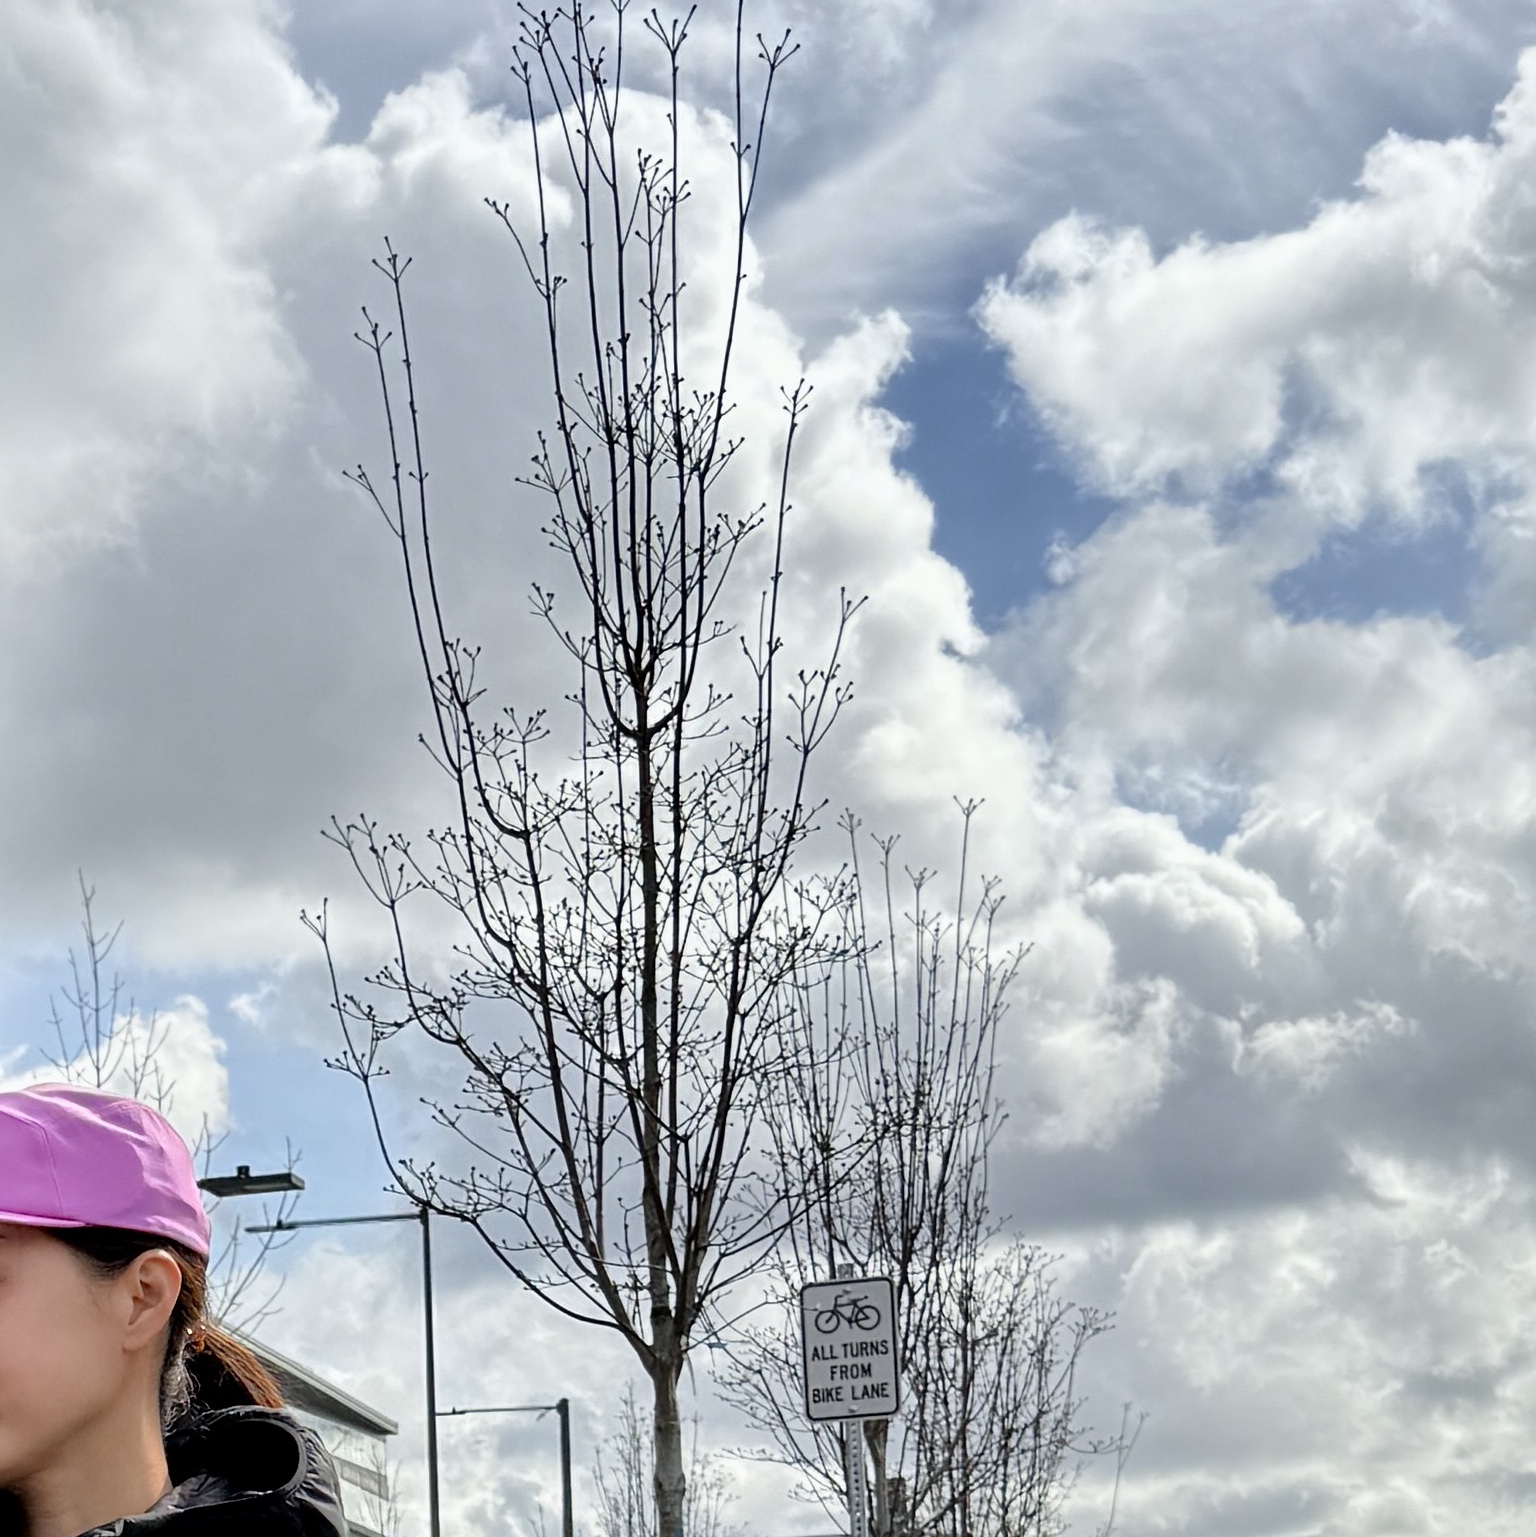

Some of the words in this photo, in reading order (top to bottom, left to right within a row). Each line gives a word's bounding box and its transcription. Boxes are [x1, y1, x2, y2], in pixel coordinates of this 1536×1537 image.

[811, 1344, 839, 1361] ALL
[841, 1339, 889, 1358] TURNS
[830, 1362, 872, 1381] FROM
[812, 1385, 844, 1403] BIKE
[851, 1381, 890, 1400] LANE
